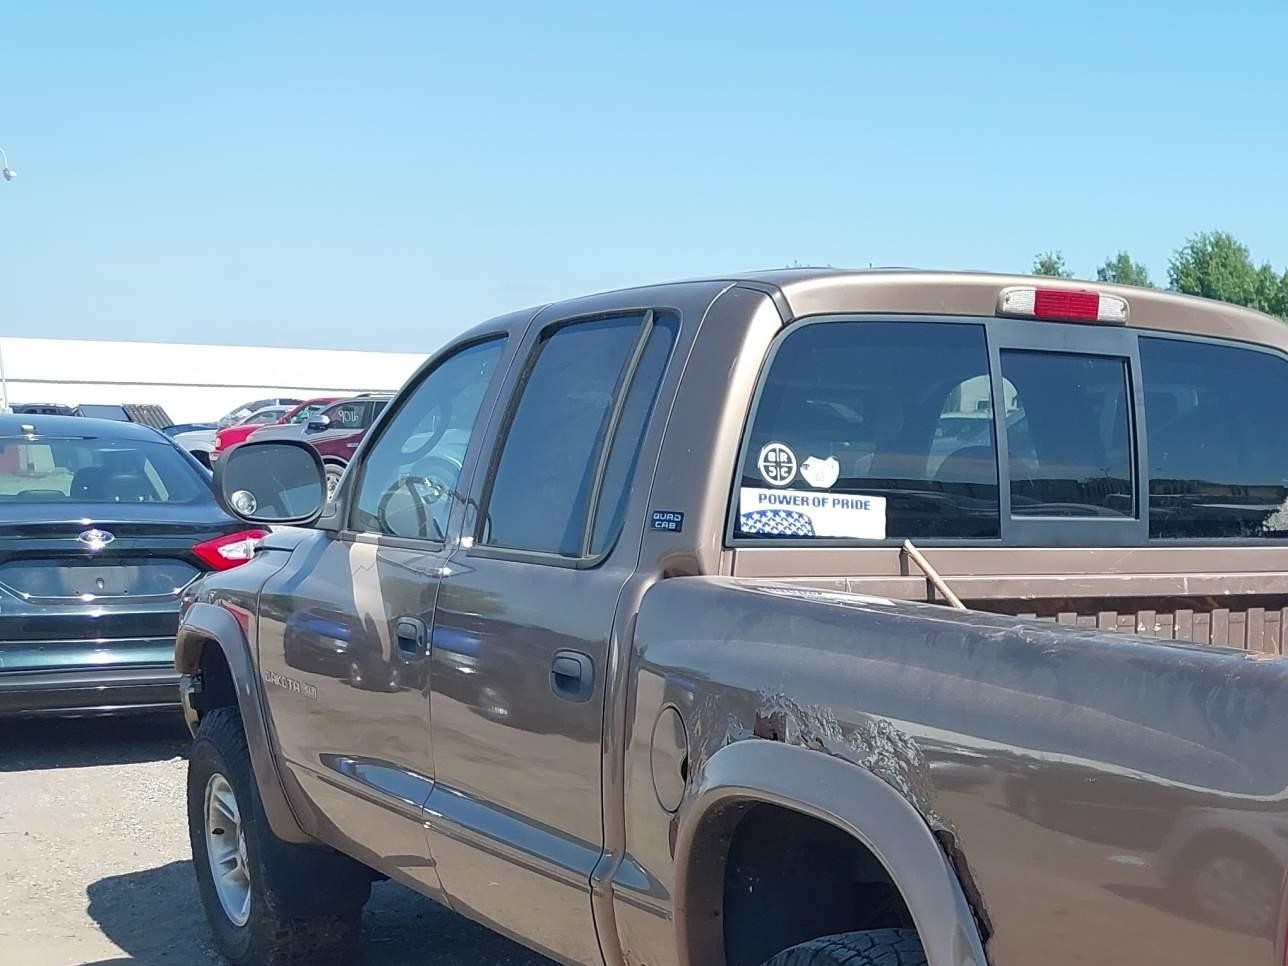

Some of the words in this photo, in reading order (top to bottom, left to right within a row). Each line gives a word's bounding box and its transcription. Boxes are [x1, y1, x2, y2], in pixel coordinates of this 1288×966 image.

[758, 493, 809, 507] POWER
[812, 496, 829, 508] OF
[832, 498, 871, 511] PRIDE
[653, 512, 682, 521] QUAD
[655, 521, 676, 529] CAB
